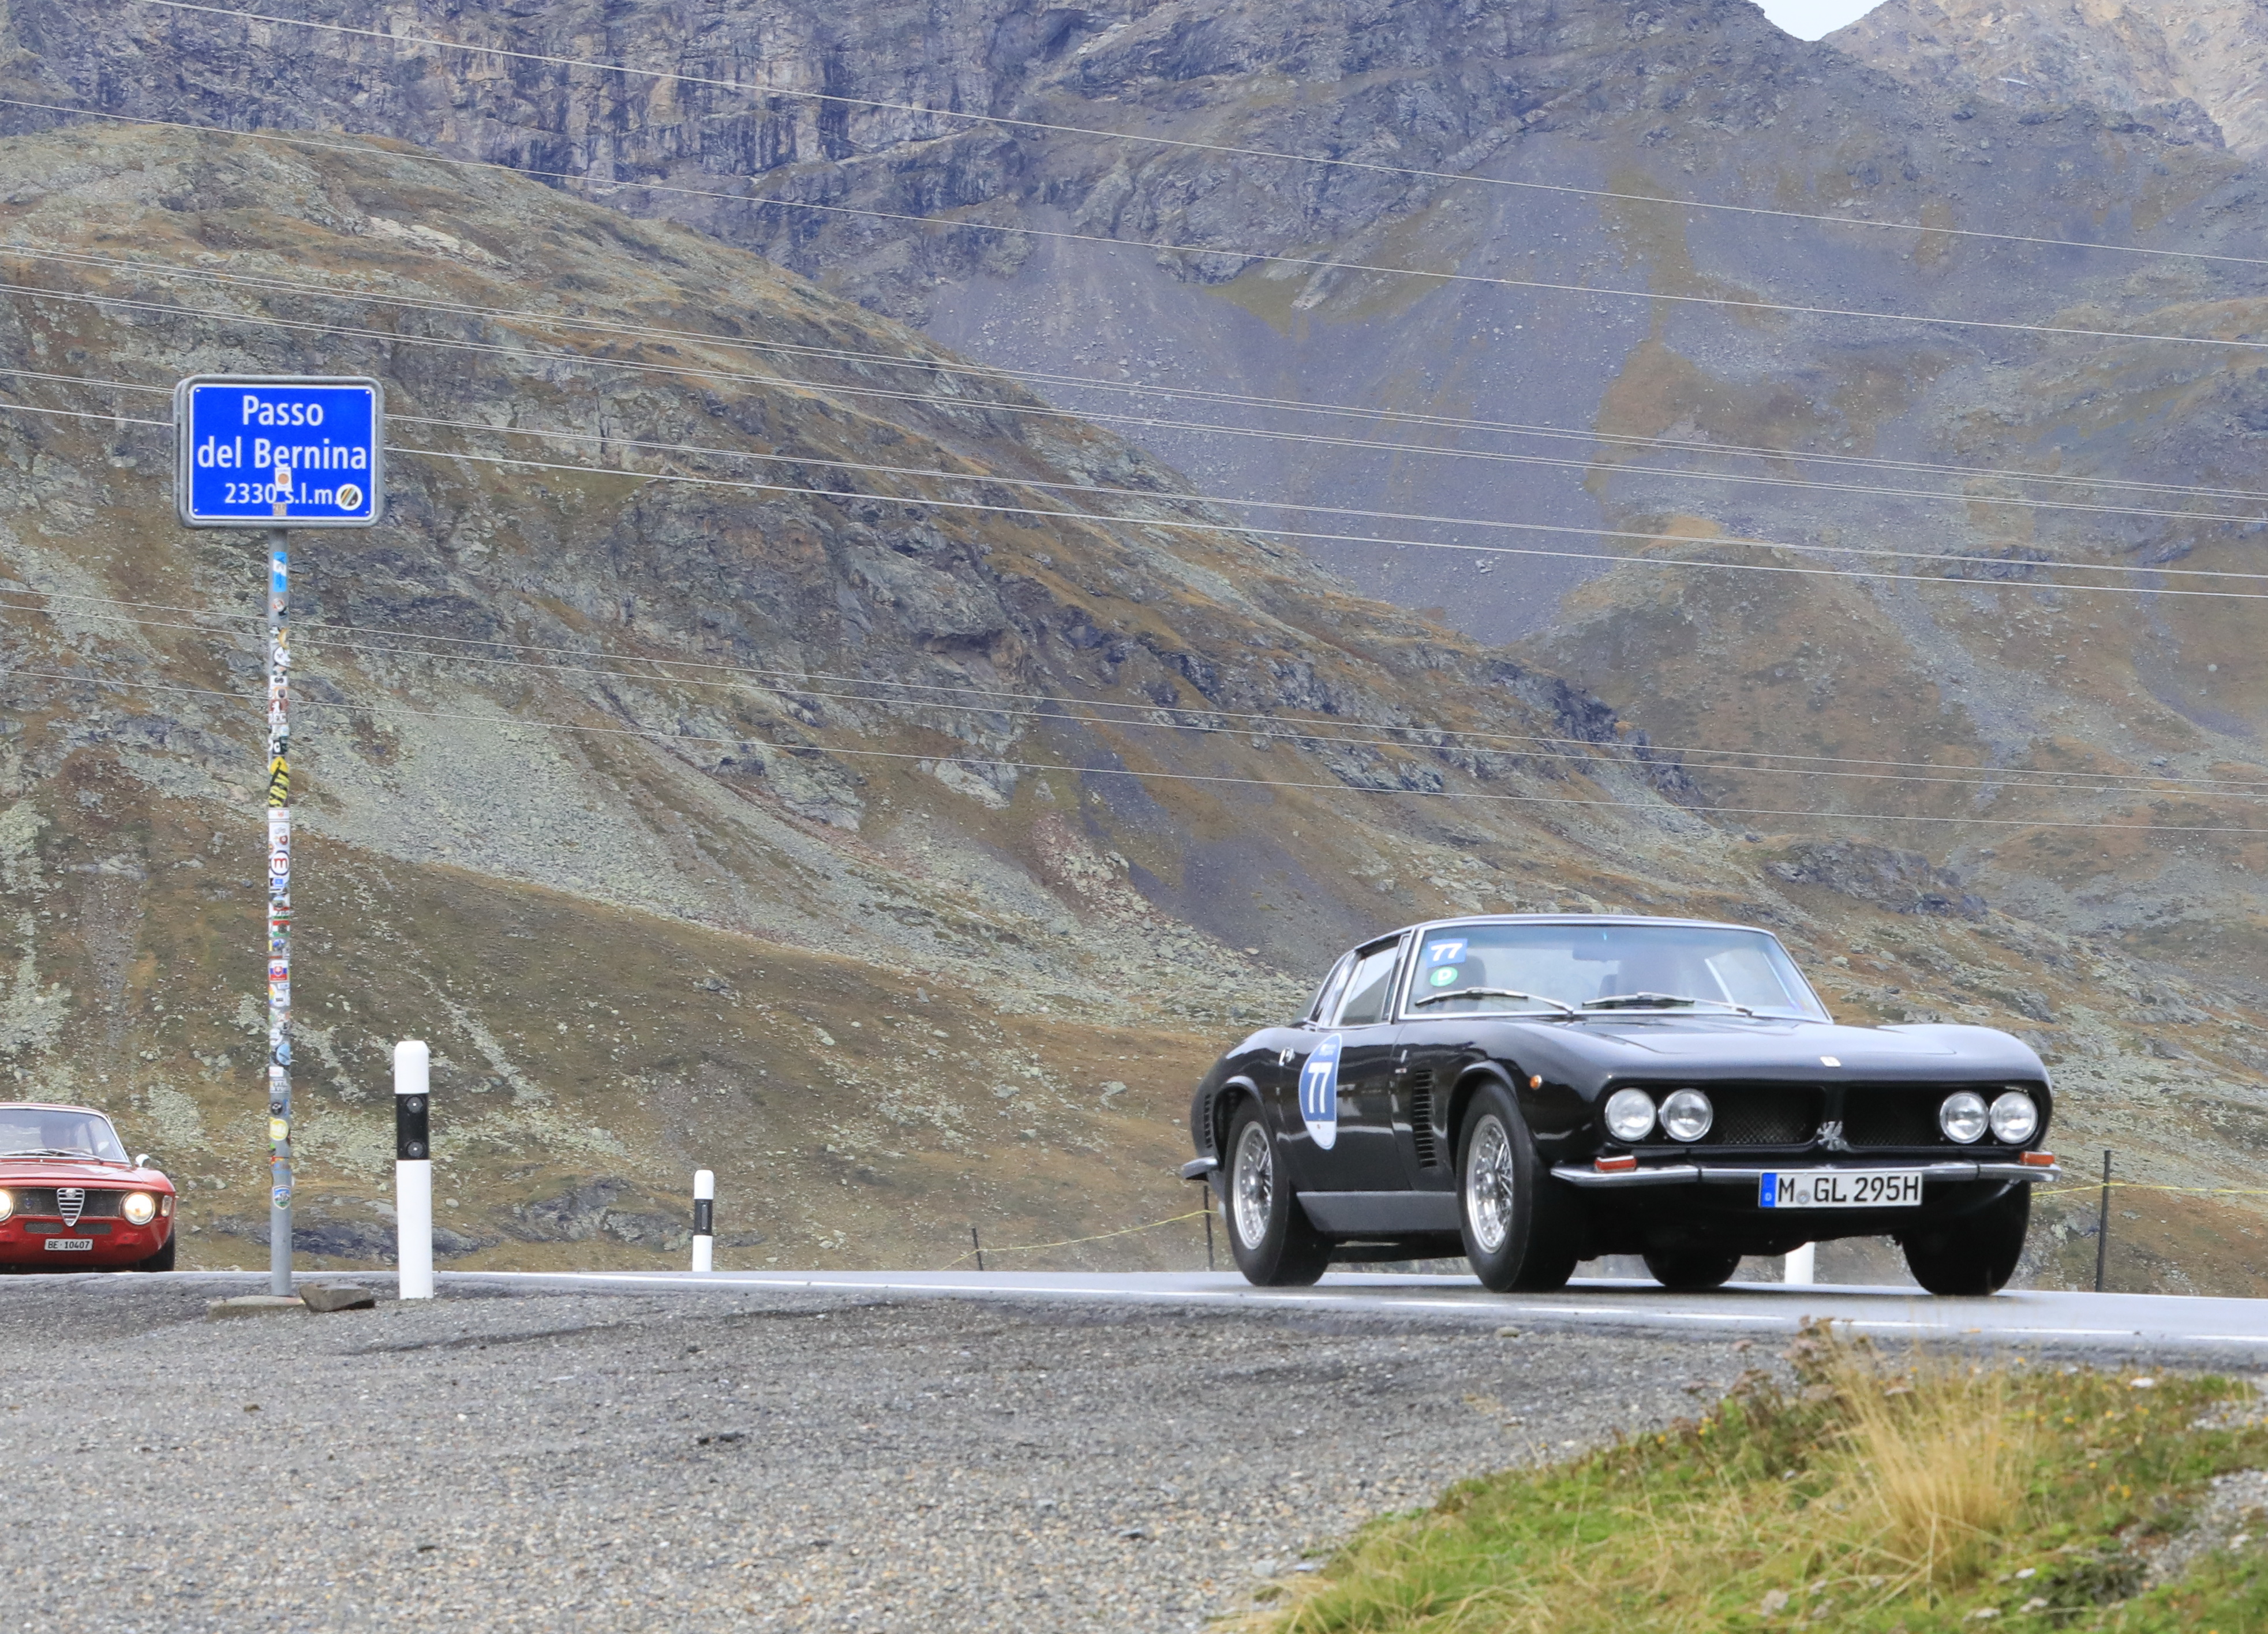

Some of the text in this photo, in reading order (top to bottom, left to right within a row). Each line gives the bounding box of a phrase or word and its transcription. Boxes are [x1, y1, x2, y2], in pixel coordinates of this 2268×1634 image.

[242, 395, 324, 426] Passo
[197, 436, 366, 470] del Bernina
[224, 483, 277, 504] 2330
[1431, 943, 1463, 962] 77
[1308, 1062, 1333, 1114] 77
[1778, 1175, 1919, 1202] M GL 295H
[48, 1241, 90, 1249] BE 10407
